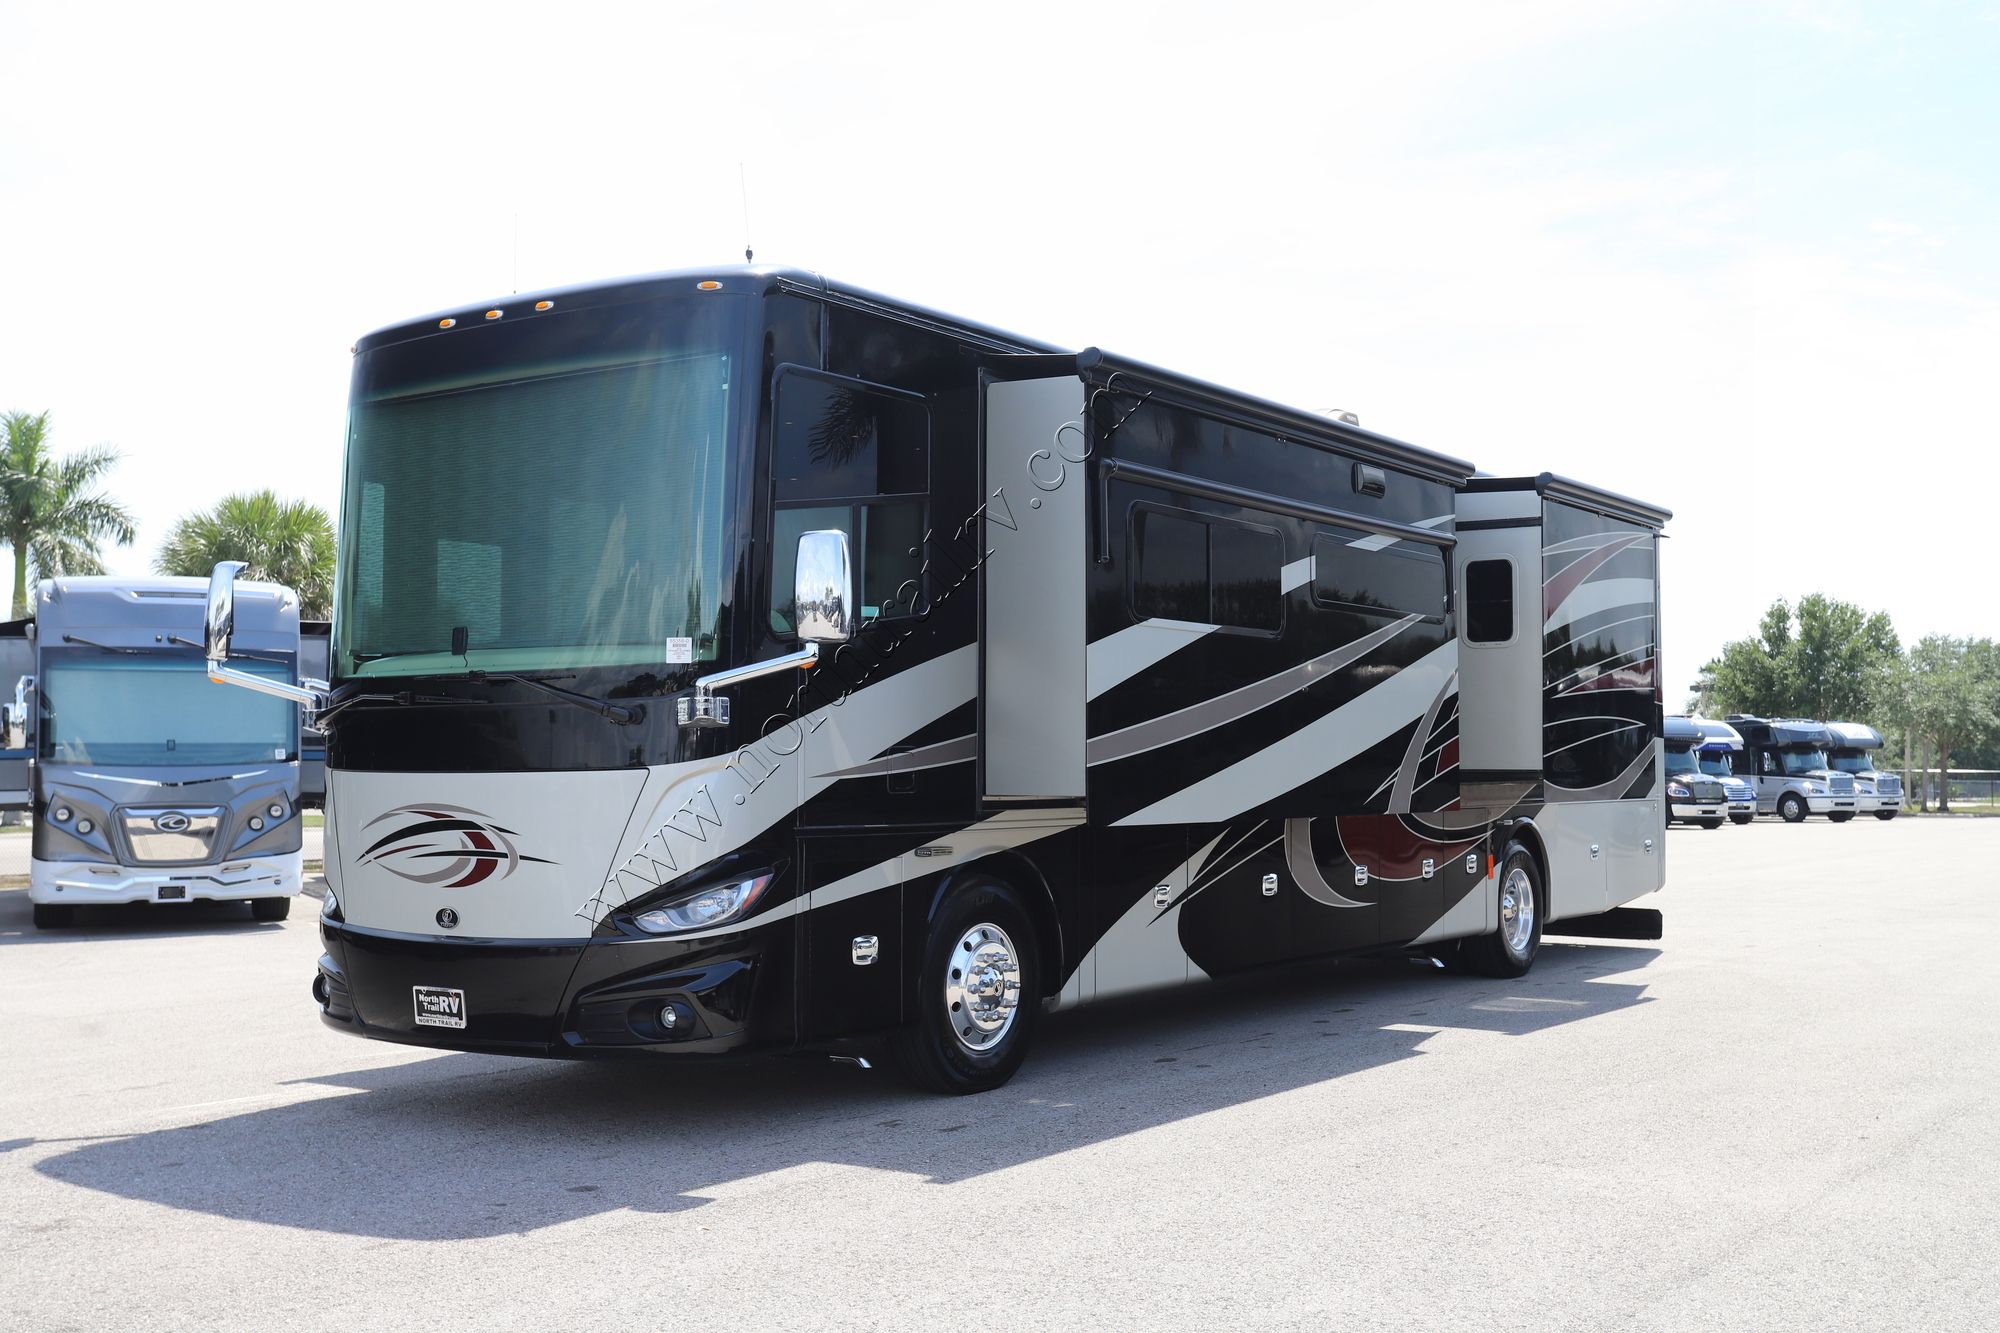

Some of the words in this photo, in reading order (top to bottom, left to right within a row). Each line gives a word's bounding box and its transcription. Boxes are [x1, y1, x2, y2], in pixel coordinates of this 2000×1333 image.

[419, 994, 439, 1003] North
[423, 1002, 439, 1011] Trail
[439, 996, 459, 1013] RV
